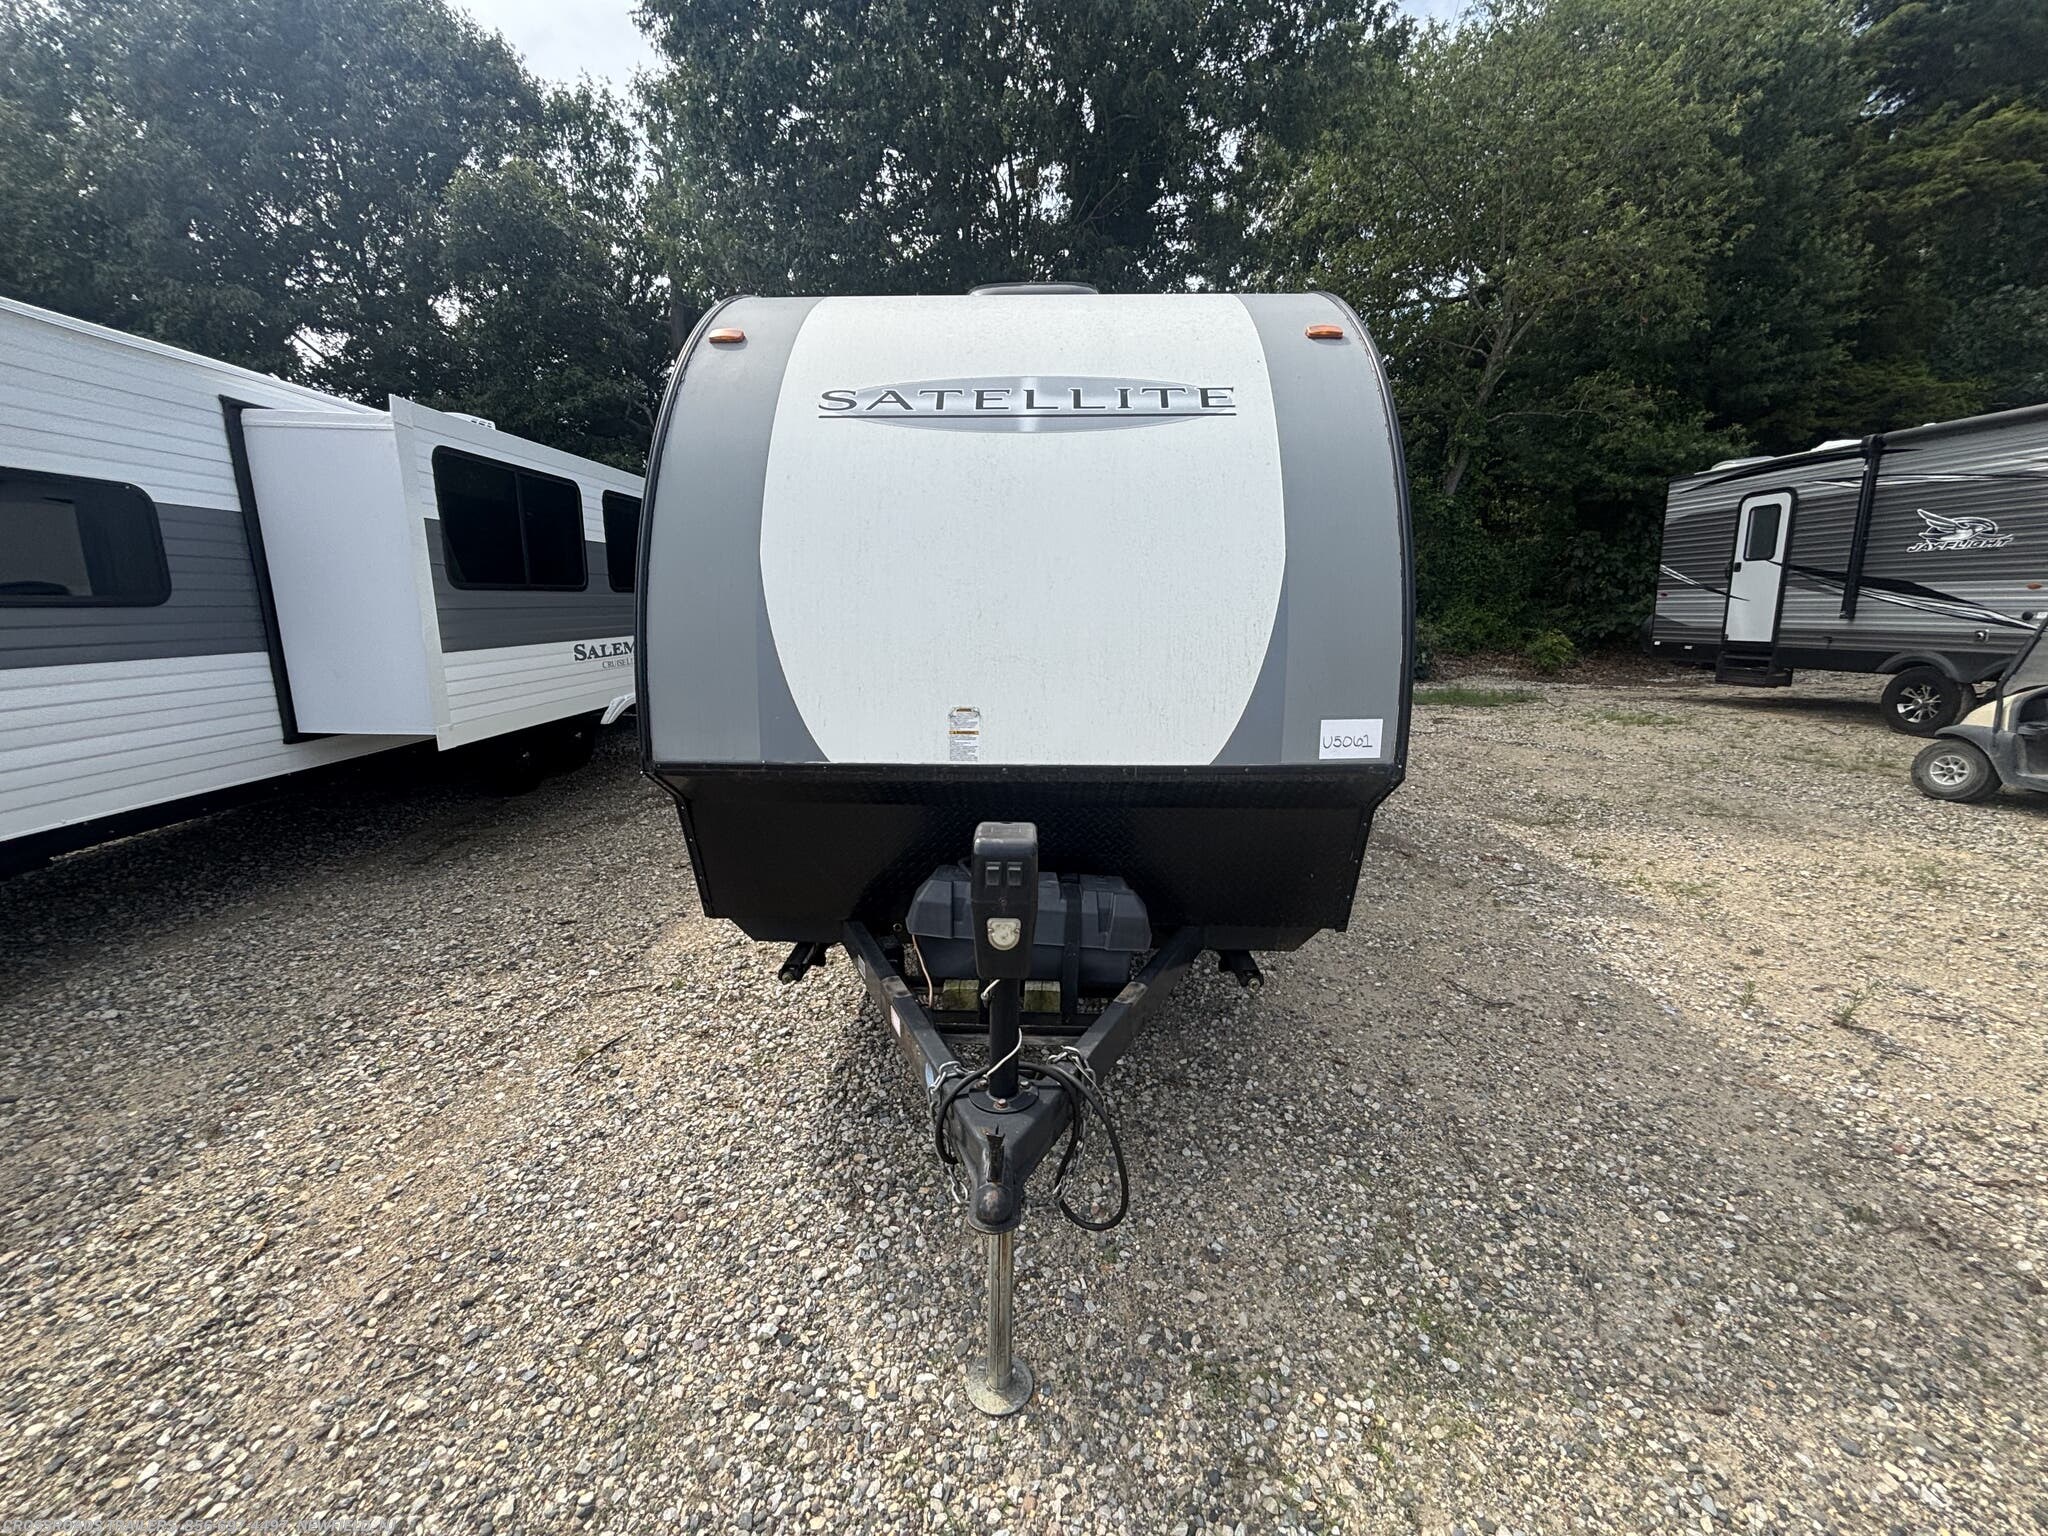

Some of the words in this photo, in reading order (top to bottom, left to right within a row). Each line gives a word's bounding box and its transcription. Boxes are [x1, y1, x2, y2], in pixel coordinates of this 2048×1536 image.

[818, 387, 1236, 411] SATELLITE
[574, 641, 635, 661] SALEM
[1322, 734, 1373, 749] U5061
